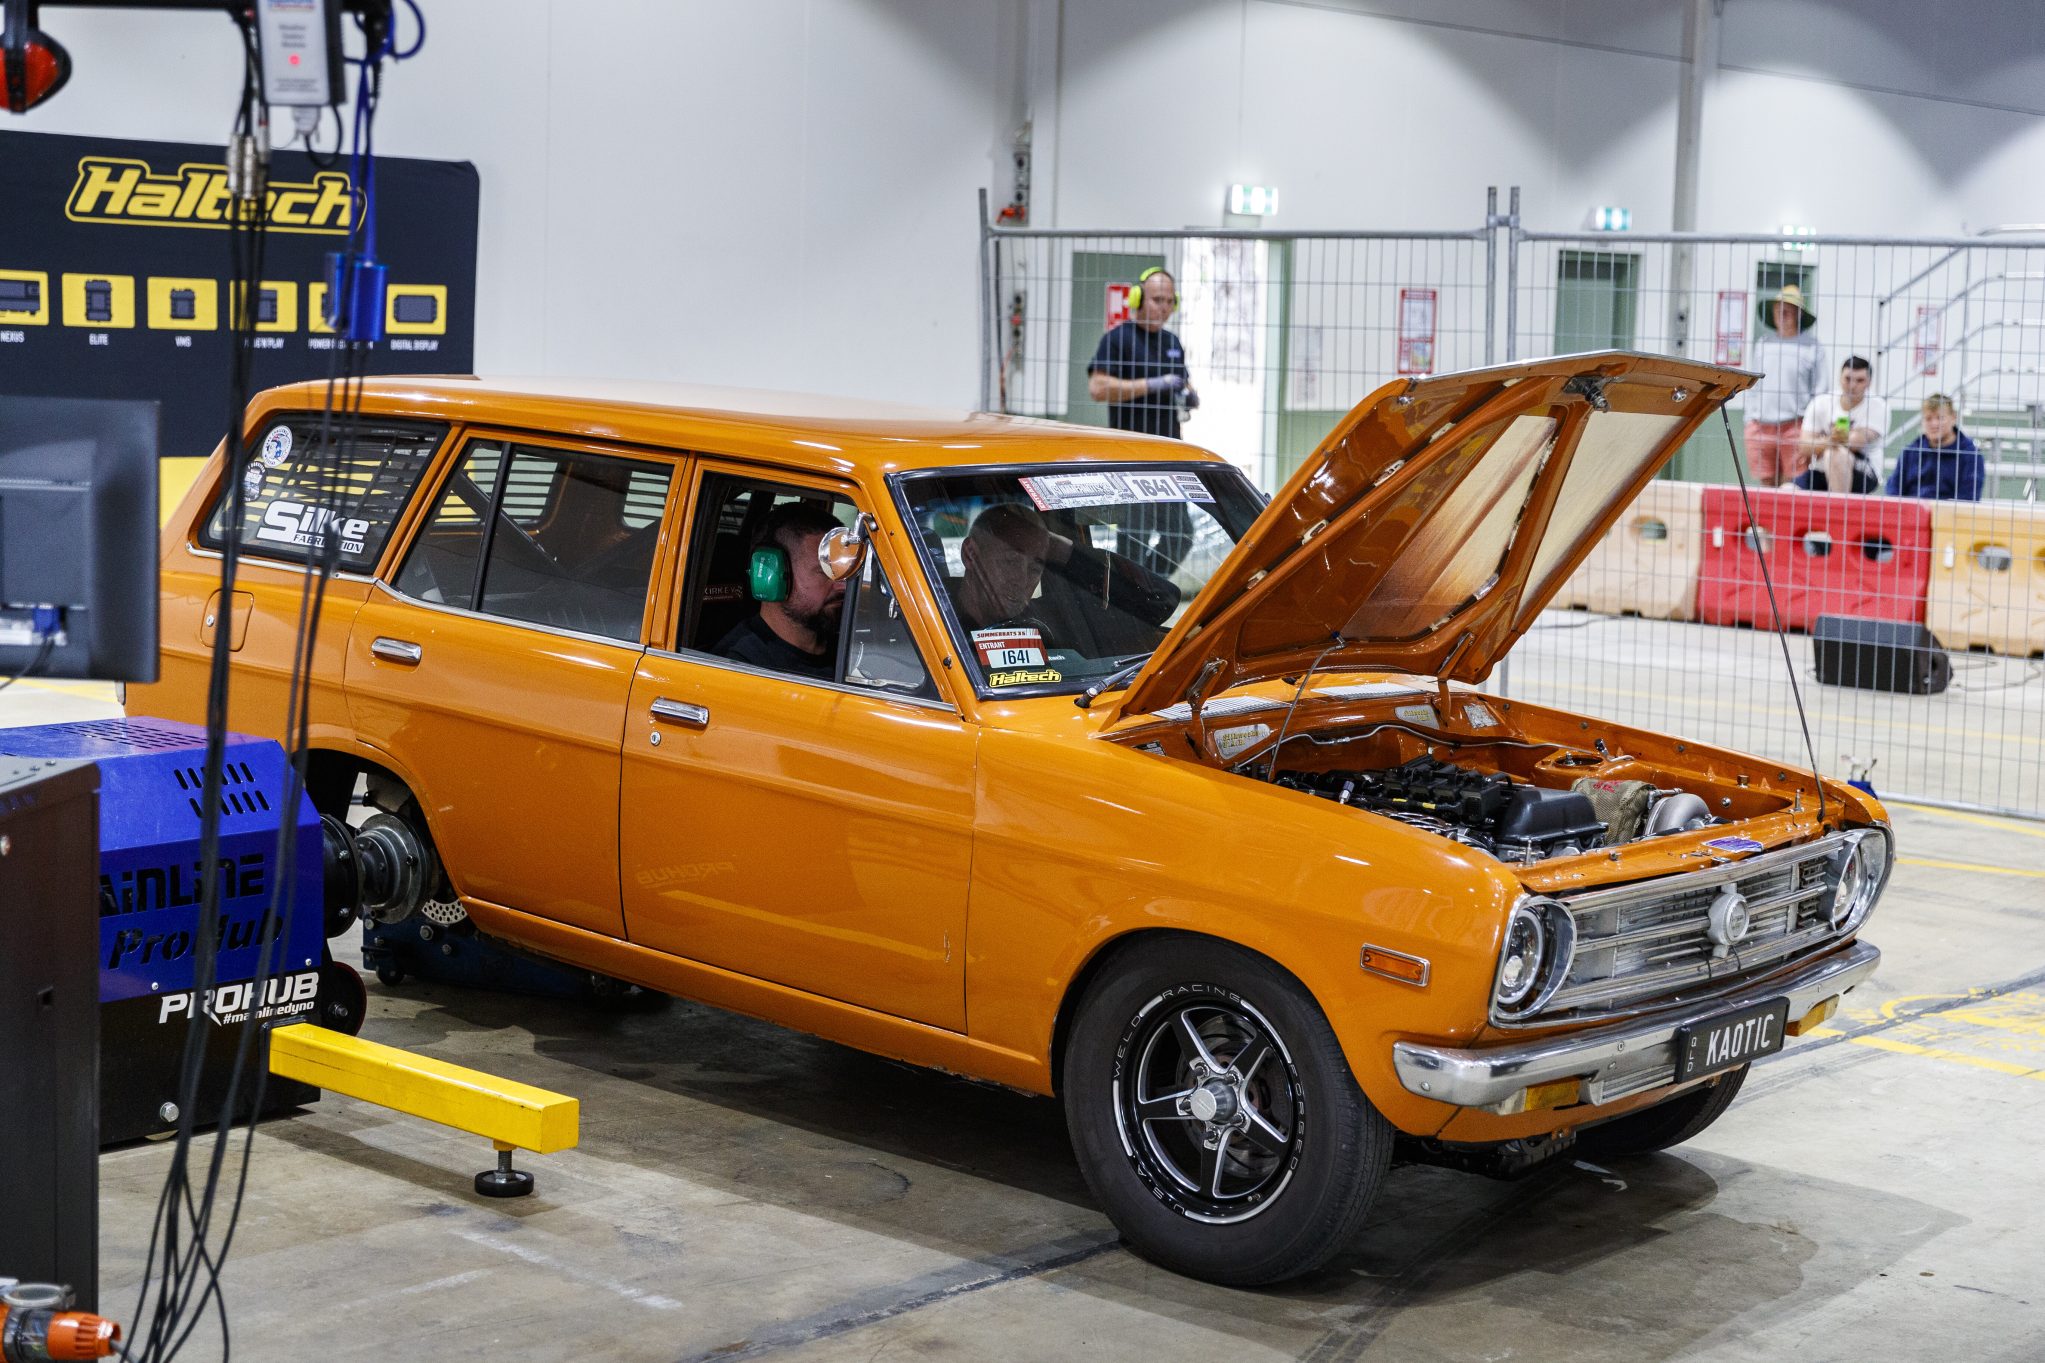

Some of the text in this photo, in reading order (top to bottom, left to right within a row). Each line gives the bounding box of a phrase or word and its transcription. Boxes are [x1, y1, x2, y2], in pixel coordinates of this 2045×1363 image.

[74, 165, 352, 227] Haltech
[0, 330, 25, 343] NEXUS
[88, 333, 109, 346] ELITE
[1131, 479, 1178, 497] 1641
[293, 533, 363, 552] FABRIION
[979, 641, 1005, 650] ENTRANT
[1002, 649, 1030, 665] 1641
[990, 670, 1061, 687] Haltech
[158, 971, 319, 1027] PROHUB
[223, 1001, 315, 1025] #manlinedyno
[1113, 984, 1241, 1079] WELD RACING
[1706, 1013, 1775, 1067] KAOTIC
[1289, 1063, 1305, 1171] FORGED
